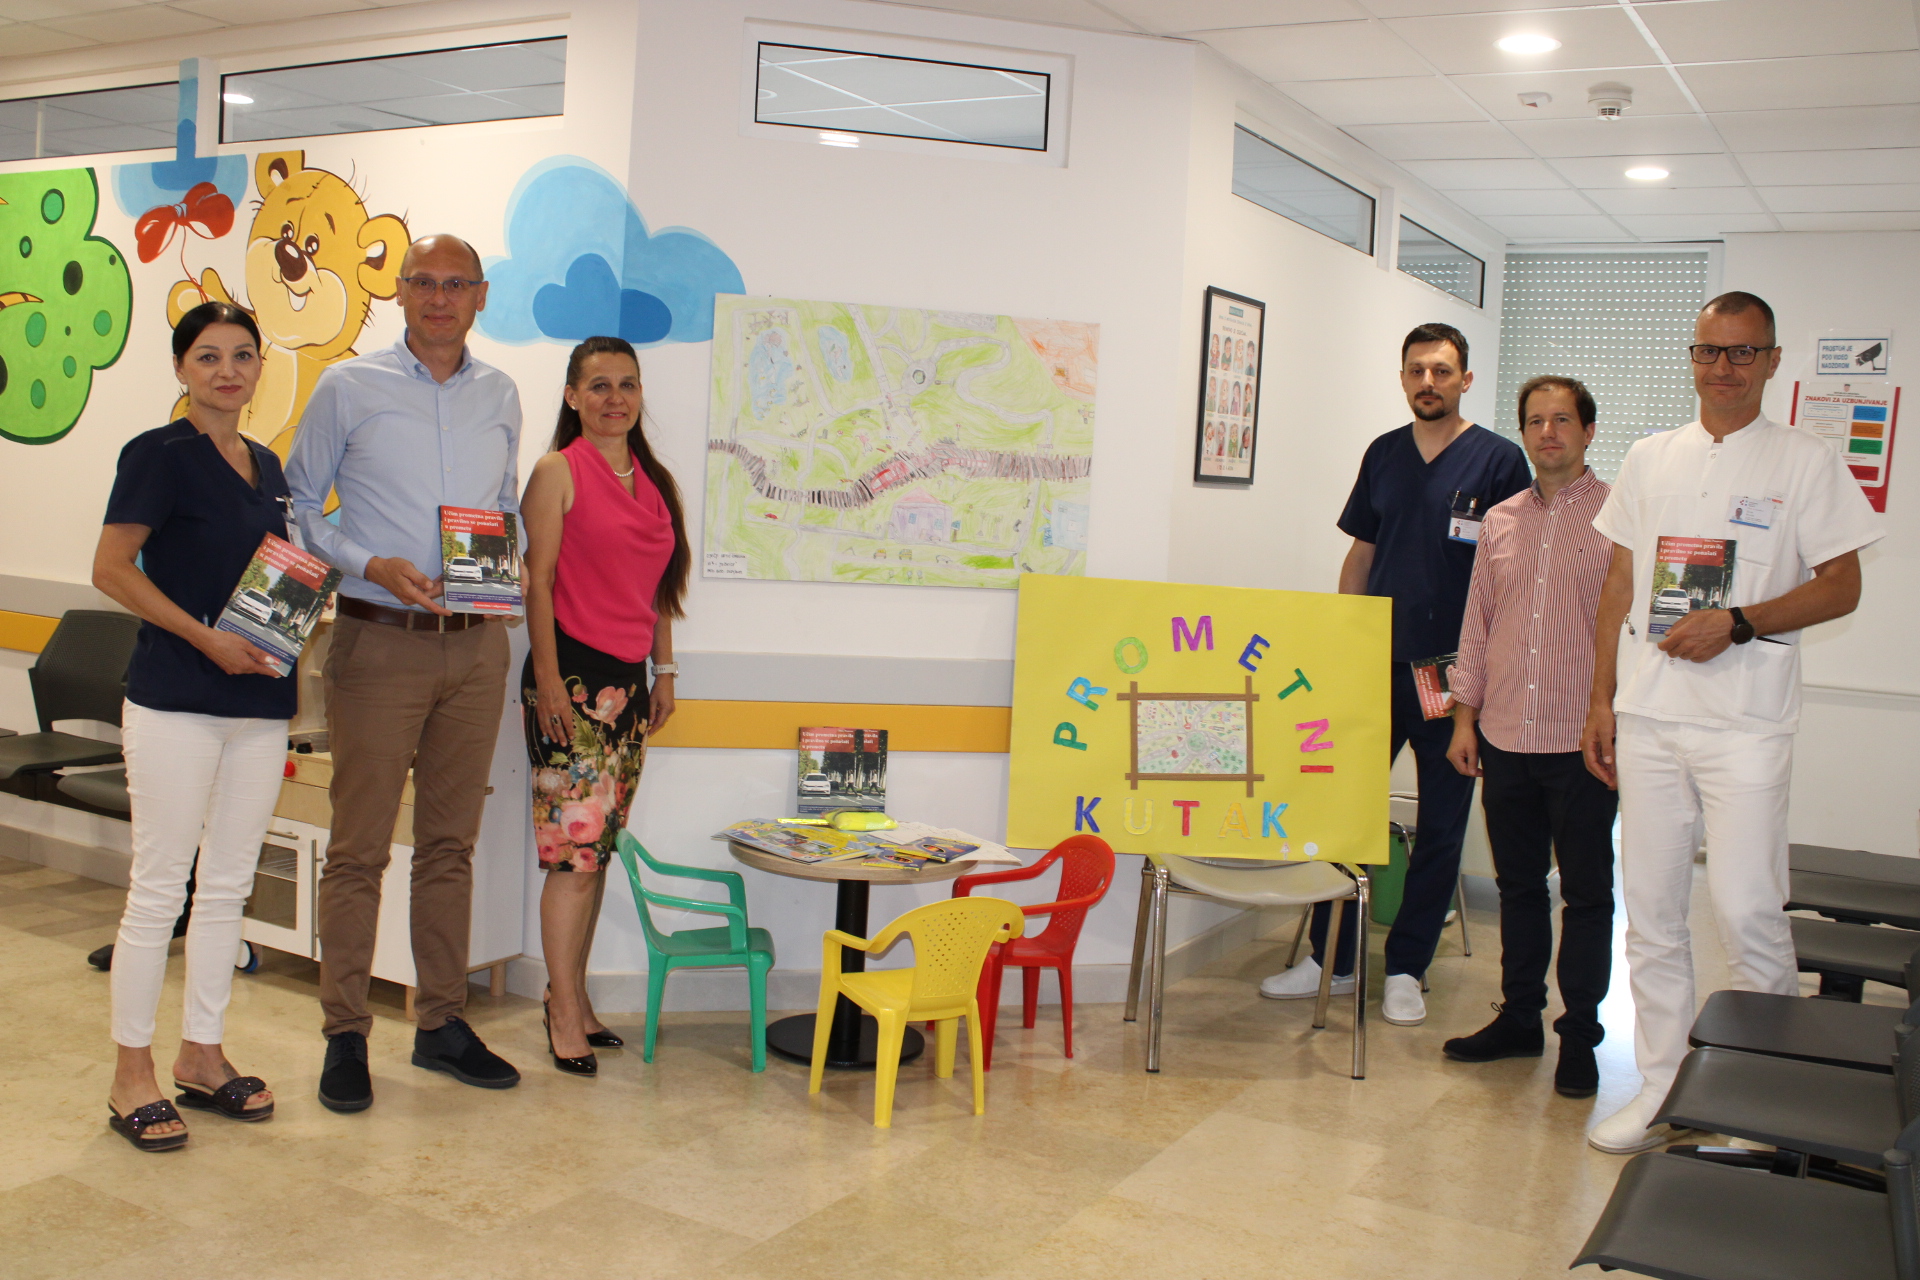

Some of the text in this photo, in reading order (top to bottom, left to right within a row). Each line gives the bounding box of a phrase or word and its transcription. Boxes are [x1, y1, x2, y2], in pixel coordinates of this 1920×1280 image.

[1841, 398, 1888, 406] UZBUNJIVANJE
[459, 512, 484, 520] prometna
[263, 555, 288, 570] prometu
[265, 548, 290, 562] pravilno
[281, 547, 308, 564] prometna
[307, 561, 328, 575] pravila
[1053, 615, 1334, 773] PROMETNI
[1074, 795, 1289, 839] KUTAK
